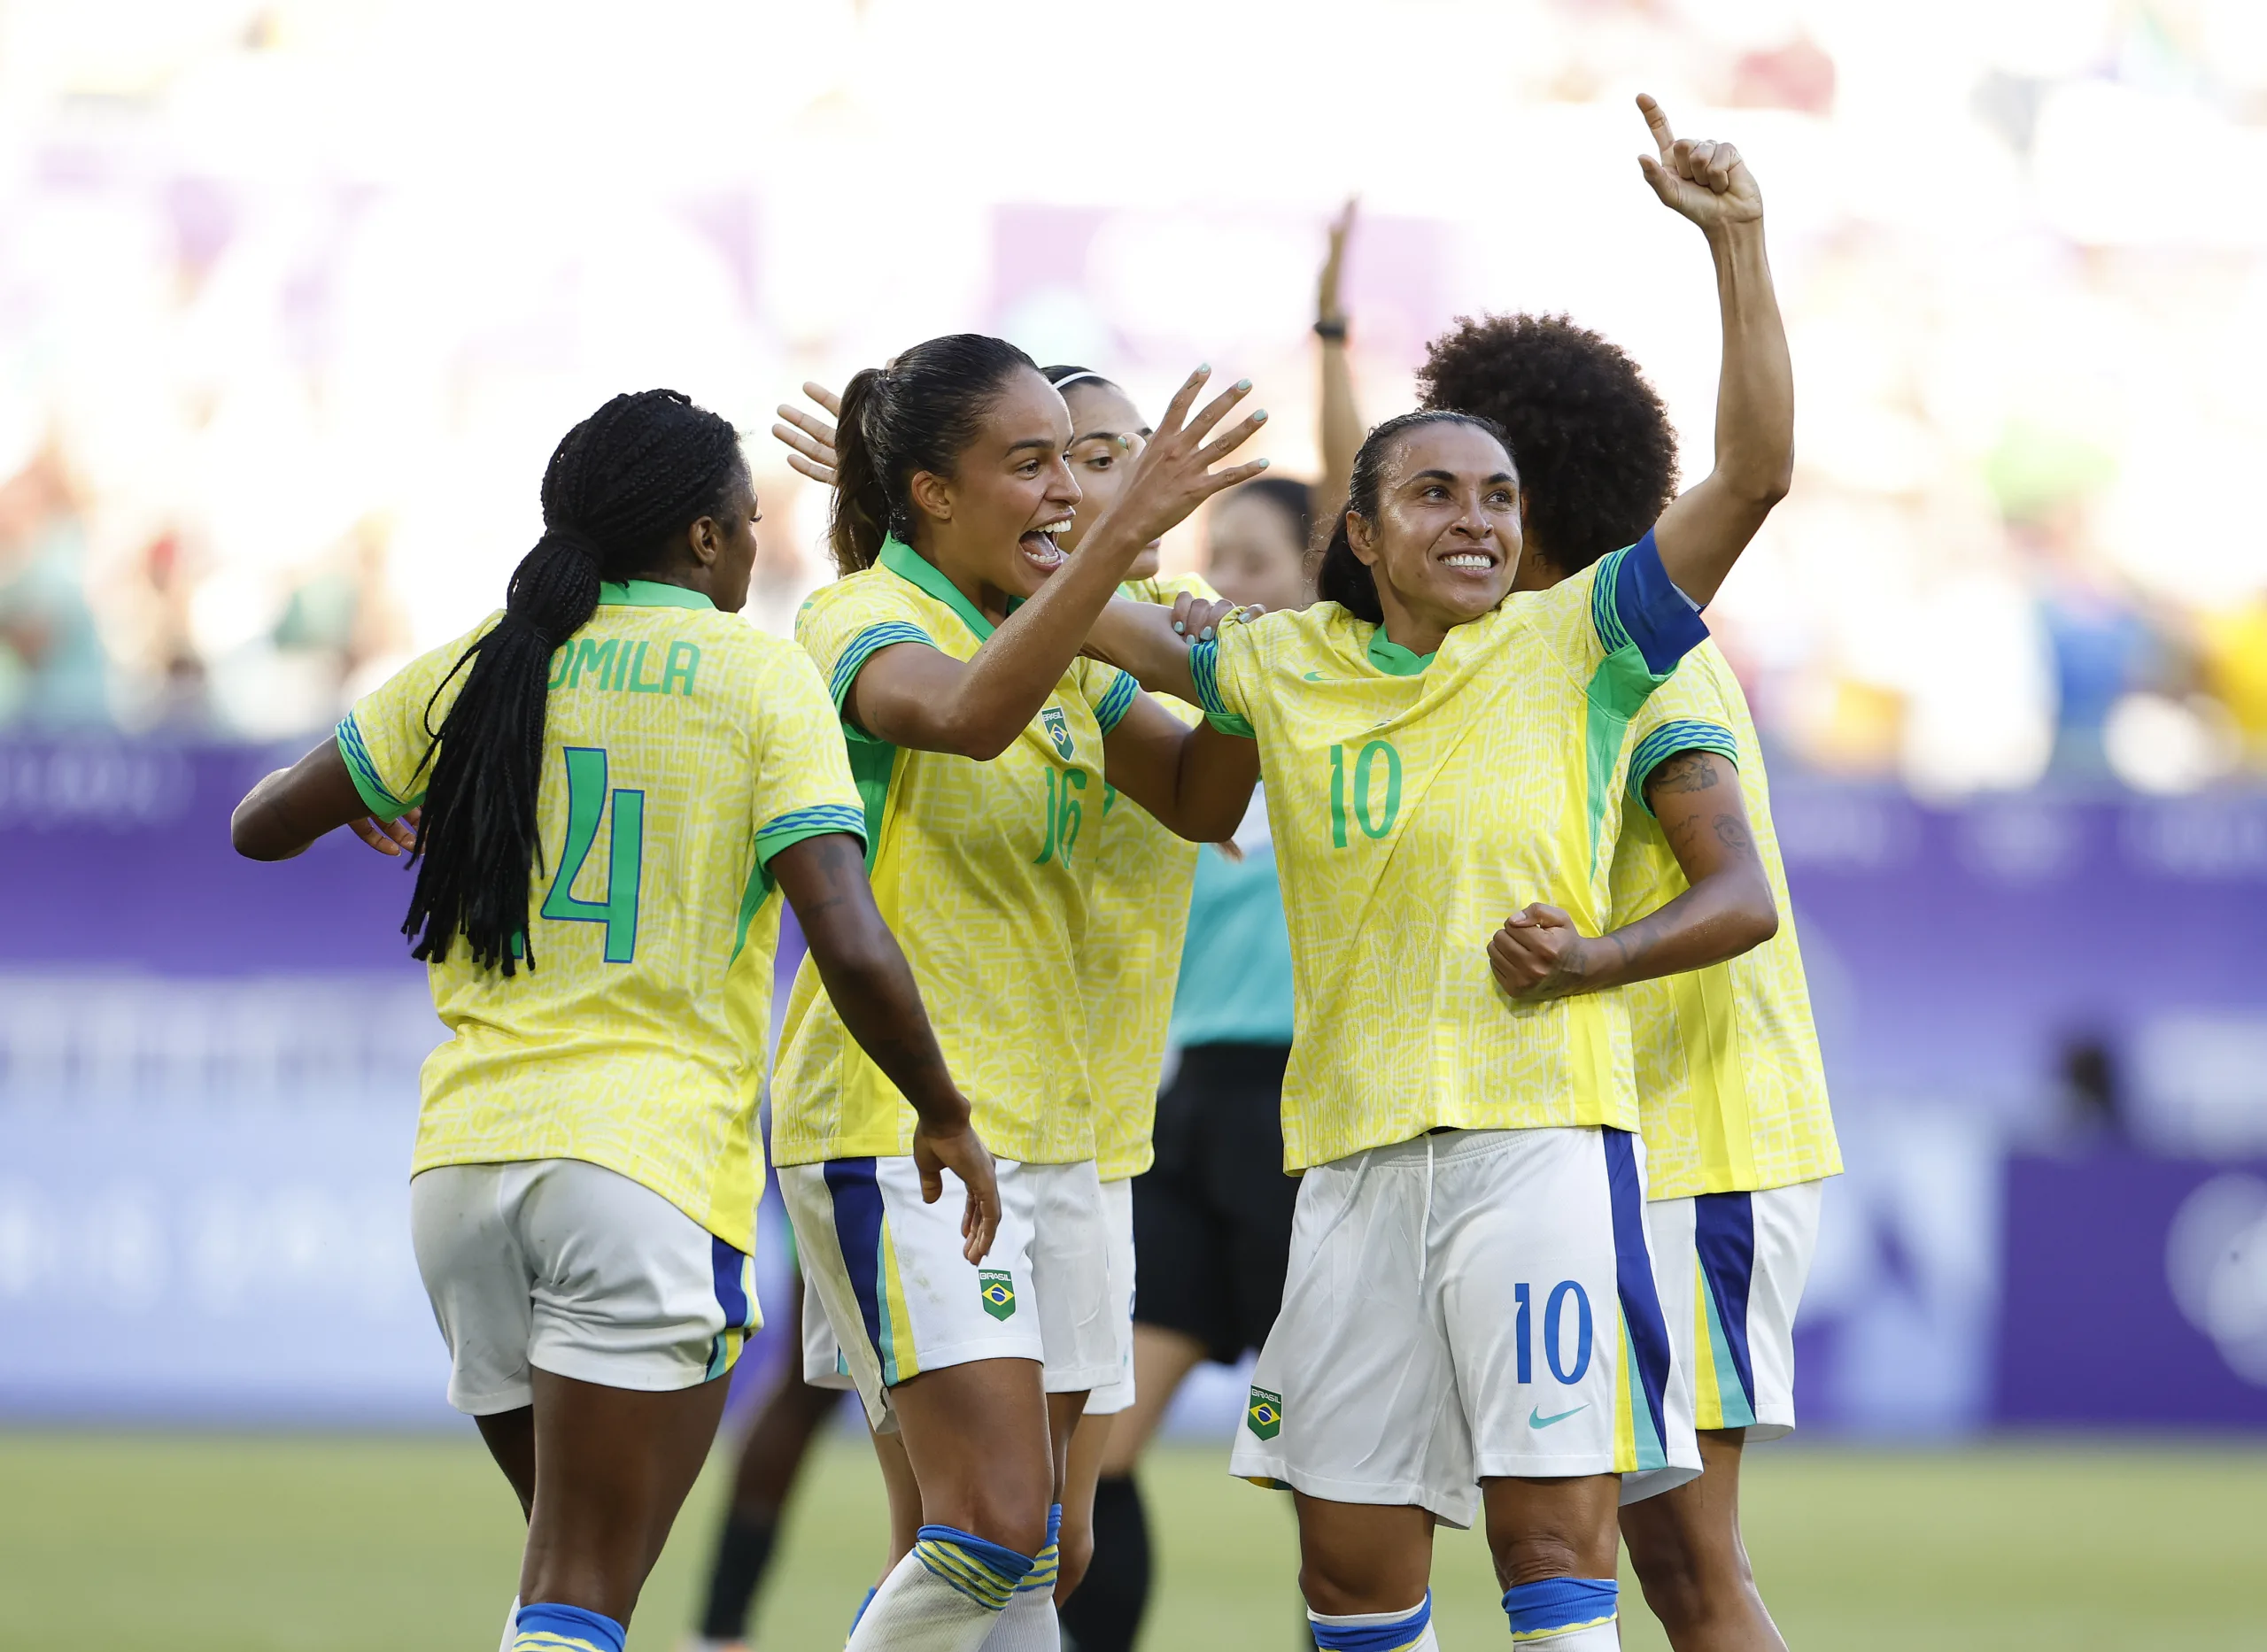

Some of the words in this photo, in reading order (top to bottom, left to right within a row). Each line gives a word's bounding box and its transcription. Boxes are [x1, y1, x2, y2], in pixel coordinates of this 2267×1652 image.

[1042, 711, 1063, 722] BRASIL
[1033, 767, 1087, 870] 16
[1330, 740, 1402, 849] 10
[511, 745, 646, 964] 4
[979, 1272, 1011, 1281] BRASIL
[1514, 1279, 1593, 1386] 10
[1251, 1388, 1281, 1404] BRASIL
